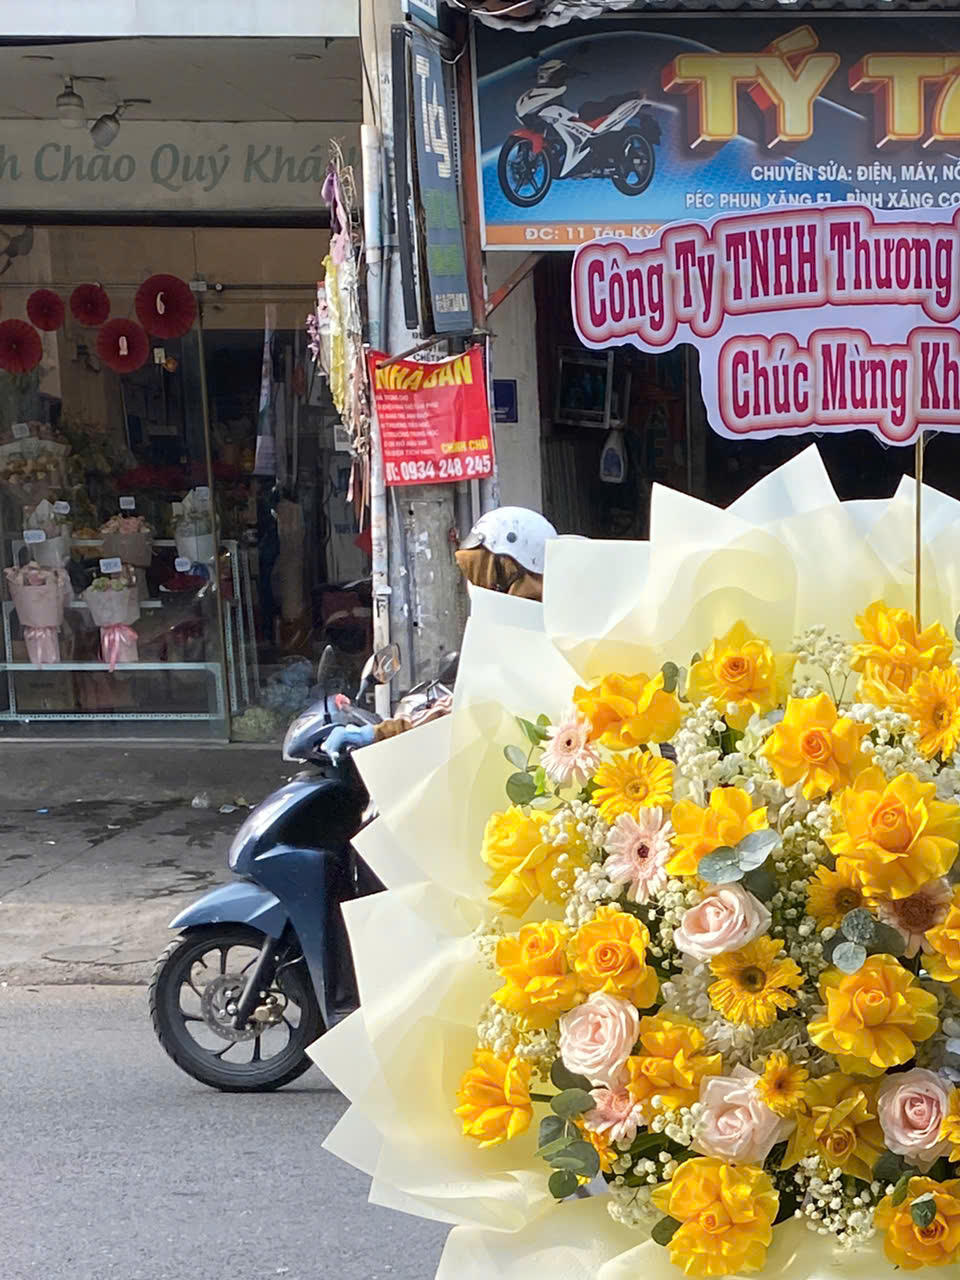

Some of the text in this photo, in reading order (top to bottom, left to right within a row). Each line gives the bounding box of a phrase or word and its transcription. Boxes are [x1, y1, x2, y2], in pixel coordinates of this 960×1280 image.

[151, 143, 231, 192] Quý
[751, 162, 814, 182] CHUYÊN
[817, 160, 852, 182] SỬA:
[857, 161, 897, 185] ĐIỆN,
[901, 161, 938, 183] MÁY,
[685, 189, 715, 208] PÉC
[720, 192, 761, 208] PHUN
[767, 190, 812, 206] XĂNG
[887, 189, 934, 208] XĂNG
[525, 227, 559, 240] ĐC:
[566, 226, 585, 240] 11
[587, 258, 664, 331] Công
[675, 240, 715, 323] Ty
[725, 224, 818, 300] TNHH
[830, 221, 953, 308] Thương
[732, 348, 809, 419] Chúc
[821, 342, 908, 426] Mừng
[400, 459, 436, 480] 0934
[439, 457, 463, 478] 248
[465, 454, 491, 476] 245
